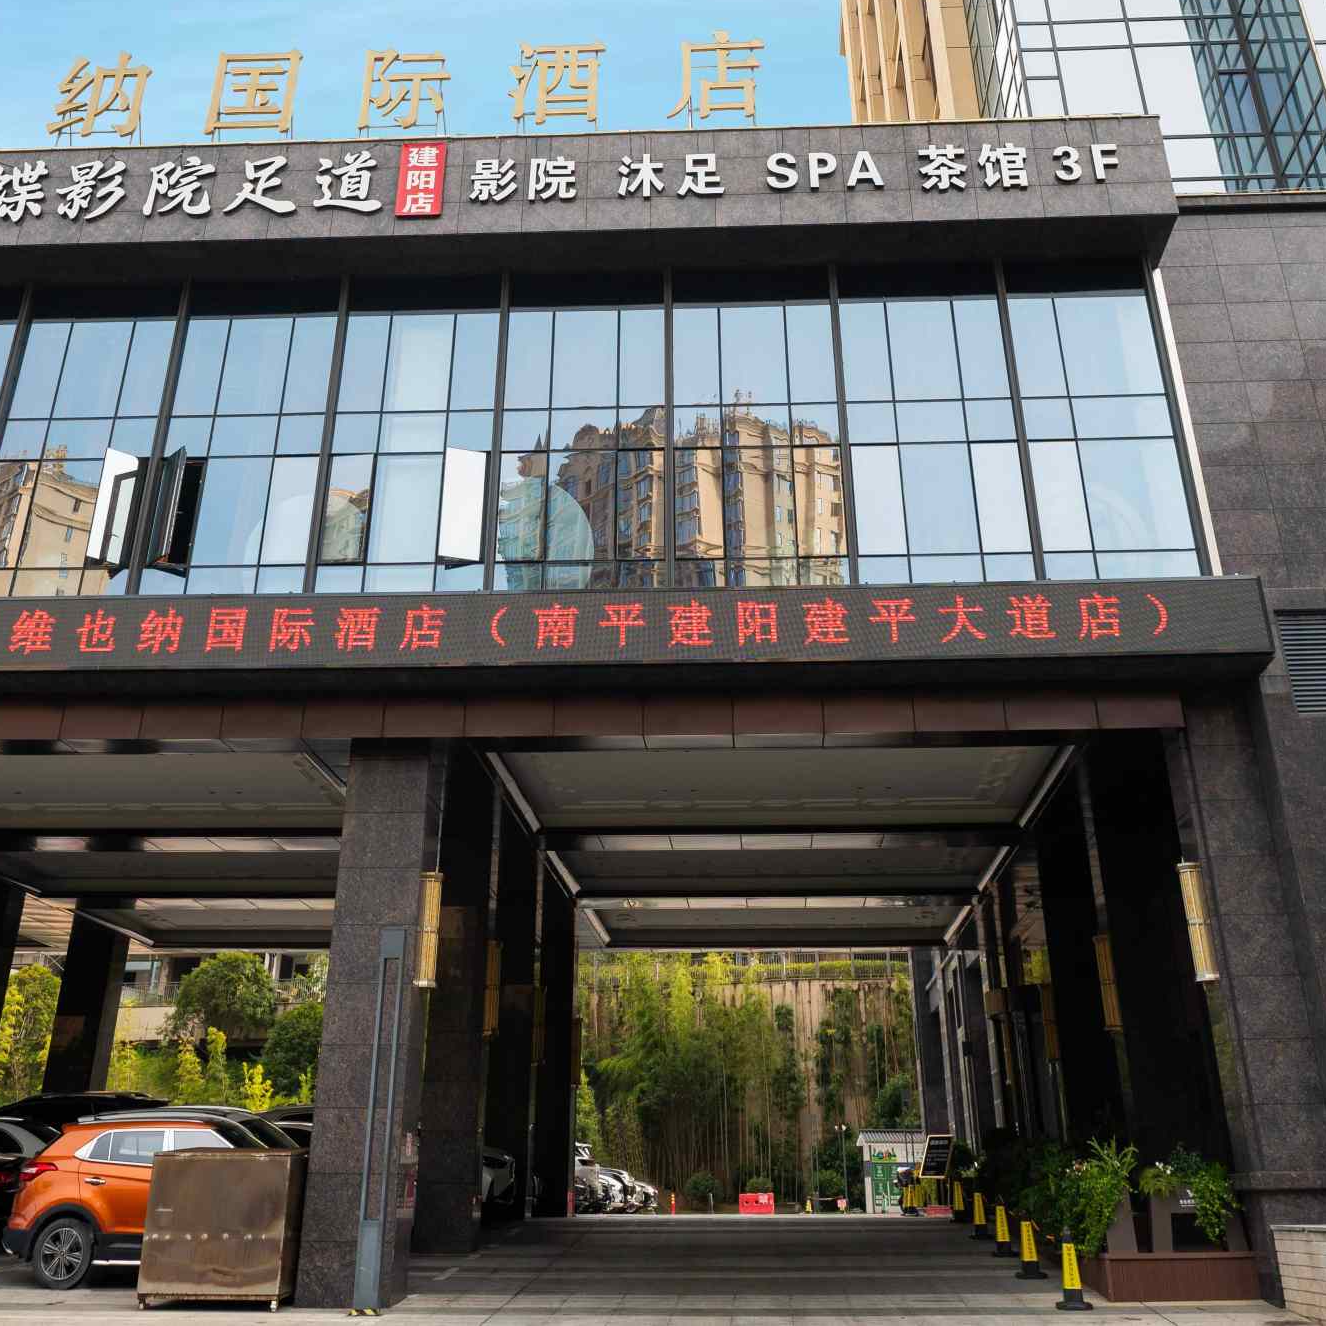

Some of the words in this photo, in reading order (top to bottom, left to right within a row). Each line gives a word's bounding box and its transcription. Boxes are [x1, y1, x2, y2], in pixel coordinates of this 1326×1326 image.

[406, 145, 440, 215] 建阳店
[469, 156, 578, 202] 影院
[617, 152, 726, 199] 沐足
[766, 149, 885, 190] SPA
[918, 143, 1029, 191] 茶馆
[1055, 143, 1120, 181] 3F
